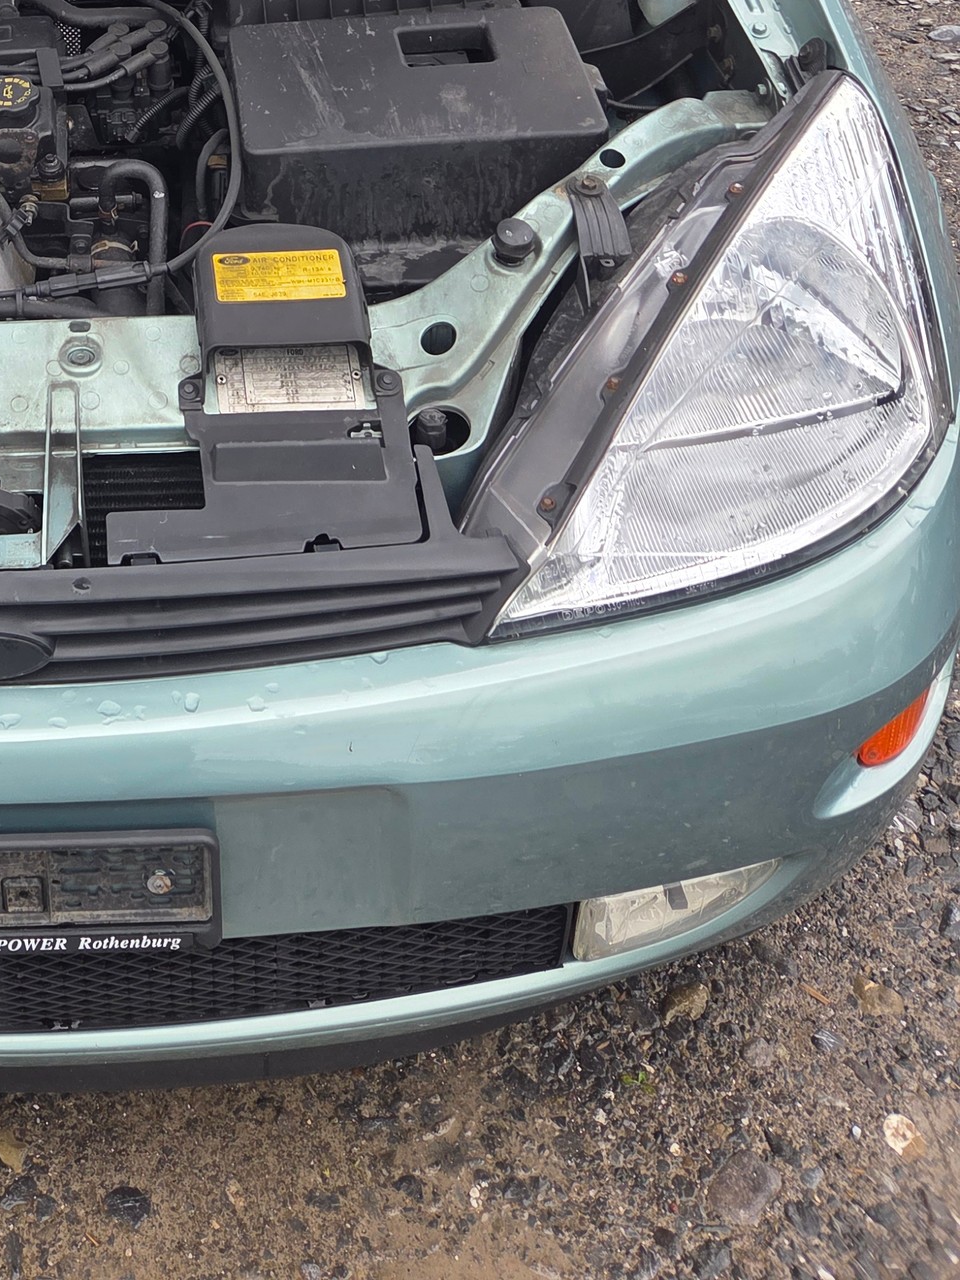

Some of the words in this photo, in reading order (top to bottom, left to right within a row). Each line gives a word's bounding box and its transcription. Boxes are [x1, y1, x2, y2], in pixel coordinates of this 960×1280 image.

[224, 257, 244, 265] Ford
[274, 254, 335, 263] CONDITIONER
[78, 935, 182, 950] Rothenburg
